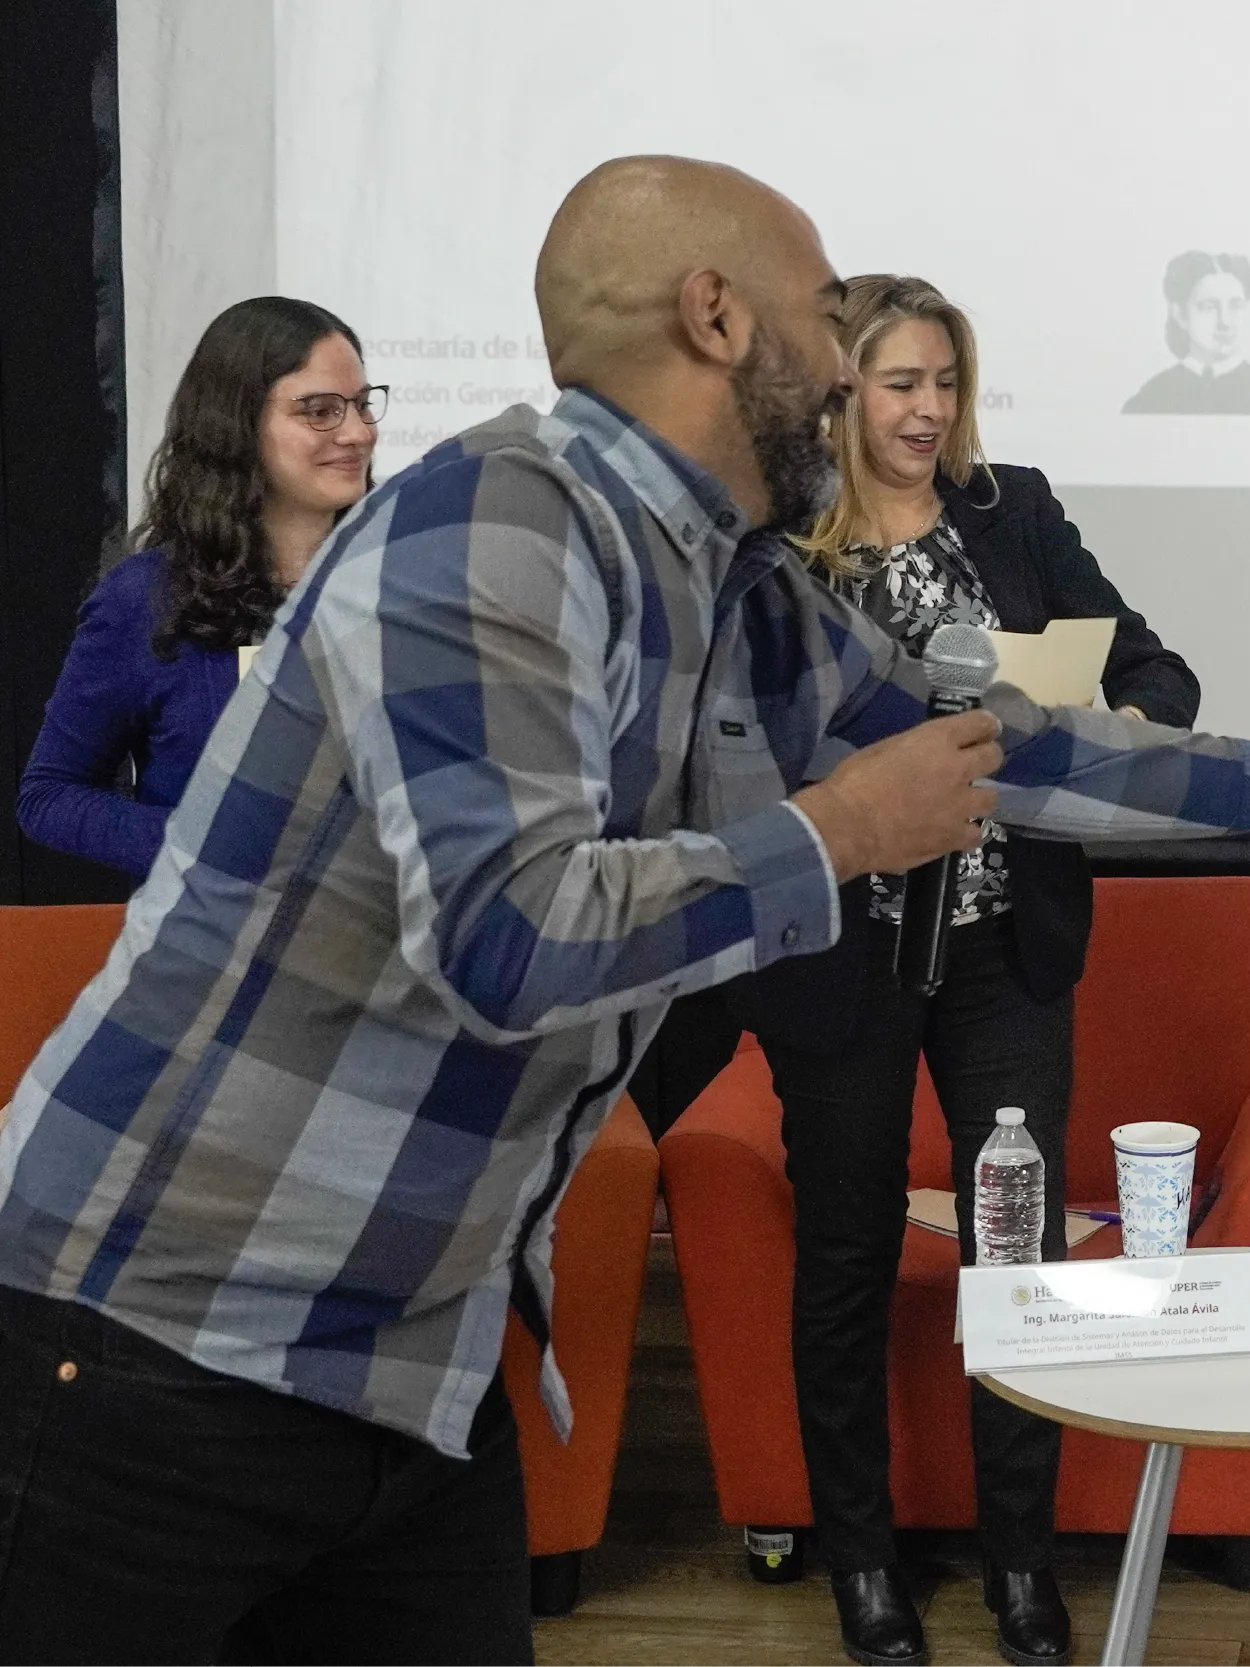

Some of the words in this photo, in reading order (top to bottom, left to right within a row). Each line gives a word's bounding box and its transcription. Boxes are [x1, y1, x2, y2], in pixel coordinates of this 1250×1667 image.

[362, 334, 476, 359] ecretaría
[482, 334, 518, 359] de
[457, 382, 545, 405] General
[1170, 1282, 1199, 1293] UPER
[1023, 1315, 1046, 1327] Ing.
[1049, 1312, 1106, 1325] Margarita
[1160, 1305, 1189, 1316] Atala
[1191, 1302, 1219, 1315] Ávila
[1021, 1337, 1031, 1346] de
[1150, 1329, 1160, 1337] de
[1183, 1327, 1200, 1337] para
